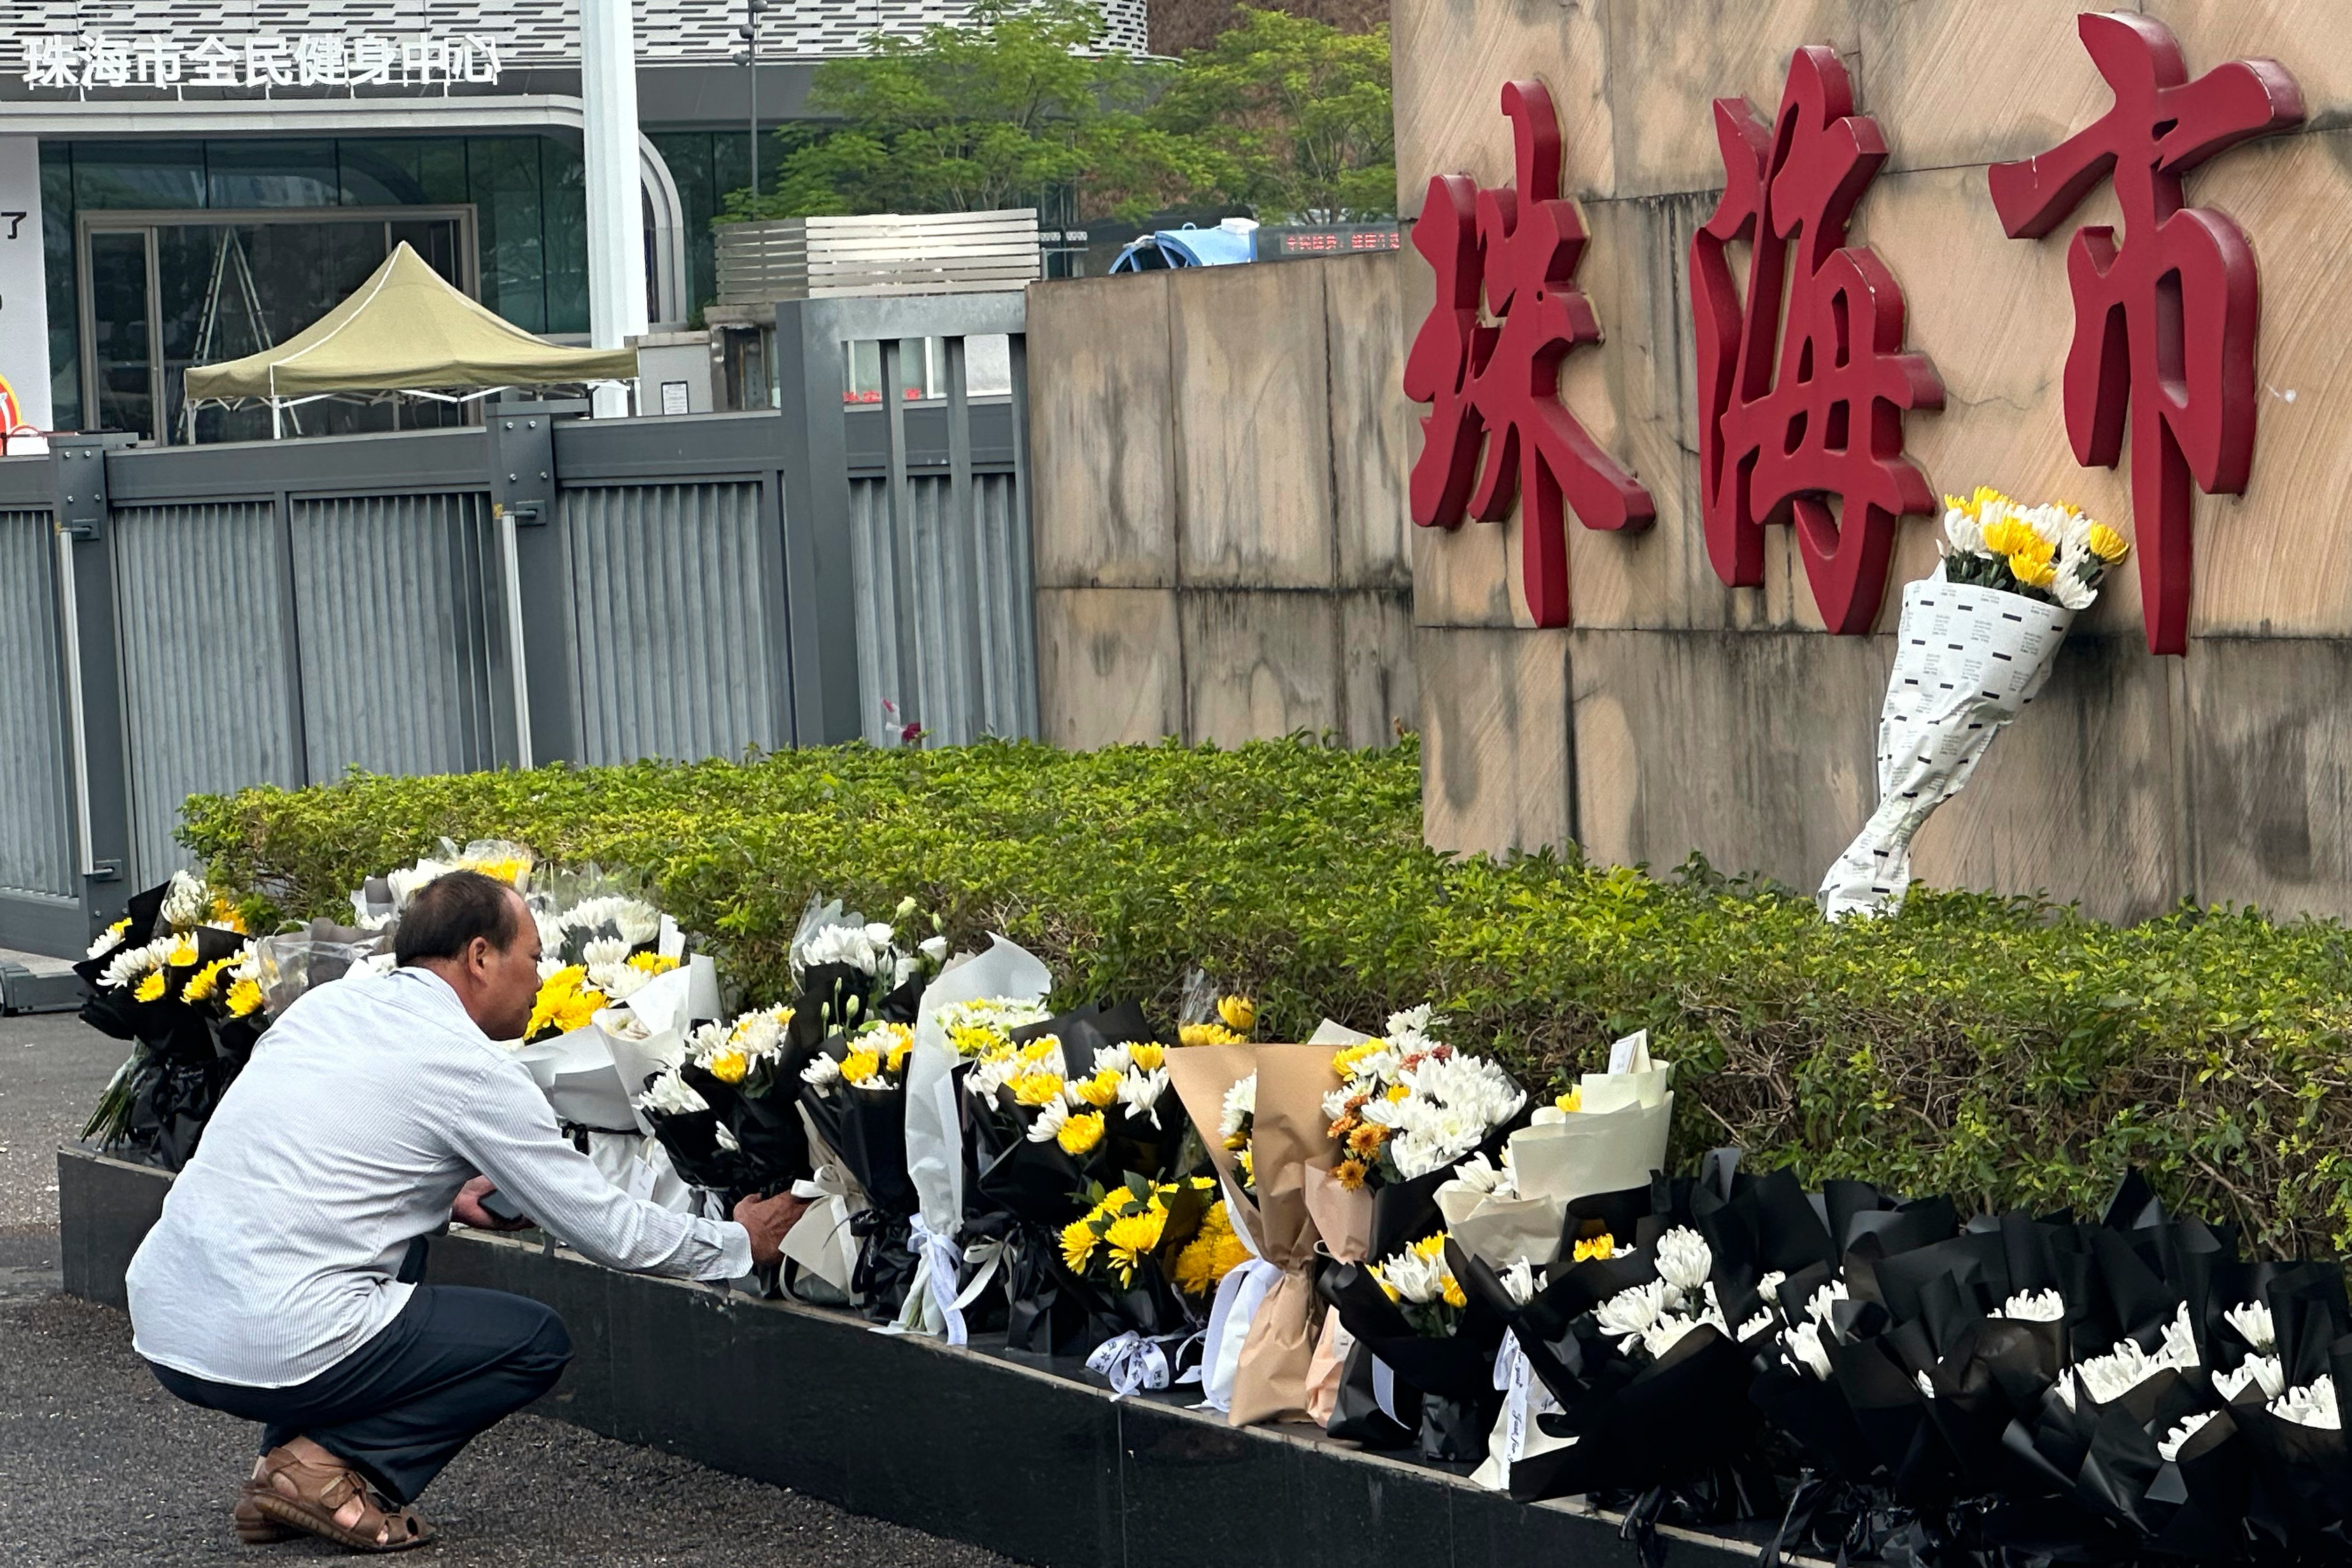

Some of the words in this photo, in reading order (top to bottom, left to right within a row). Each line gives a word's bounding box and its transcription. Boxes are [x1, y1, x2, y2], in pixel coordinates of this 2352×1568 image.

[22, 33, 502, 88] 珠海市全民健身中心
[1, 212, 26, 239] 了
[1402, 11, 2306, 657] 珠海市
